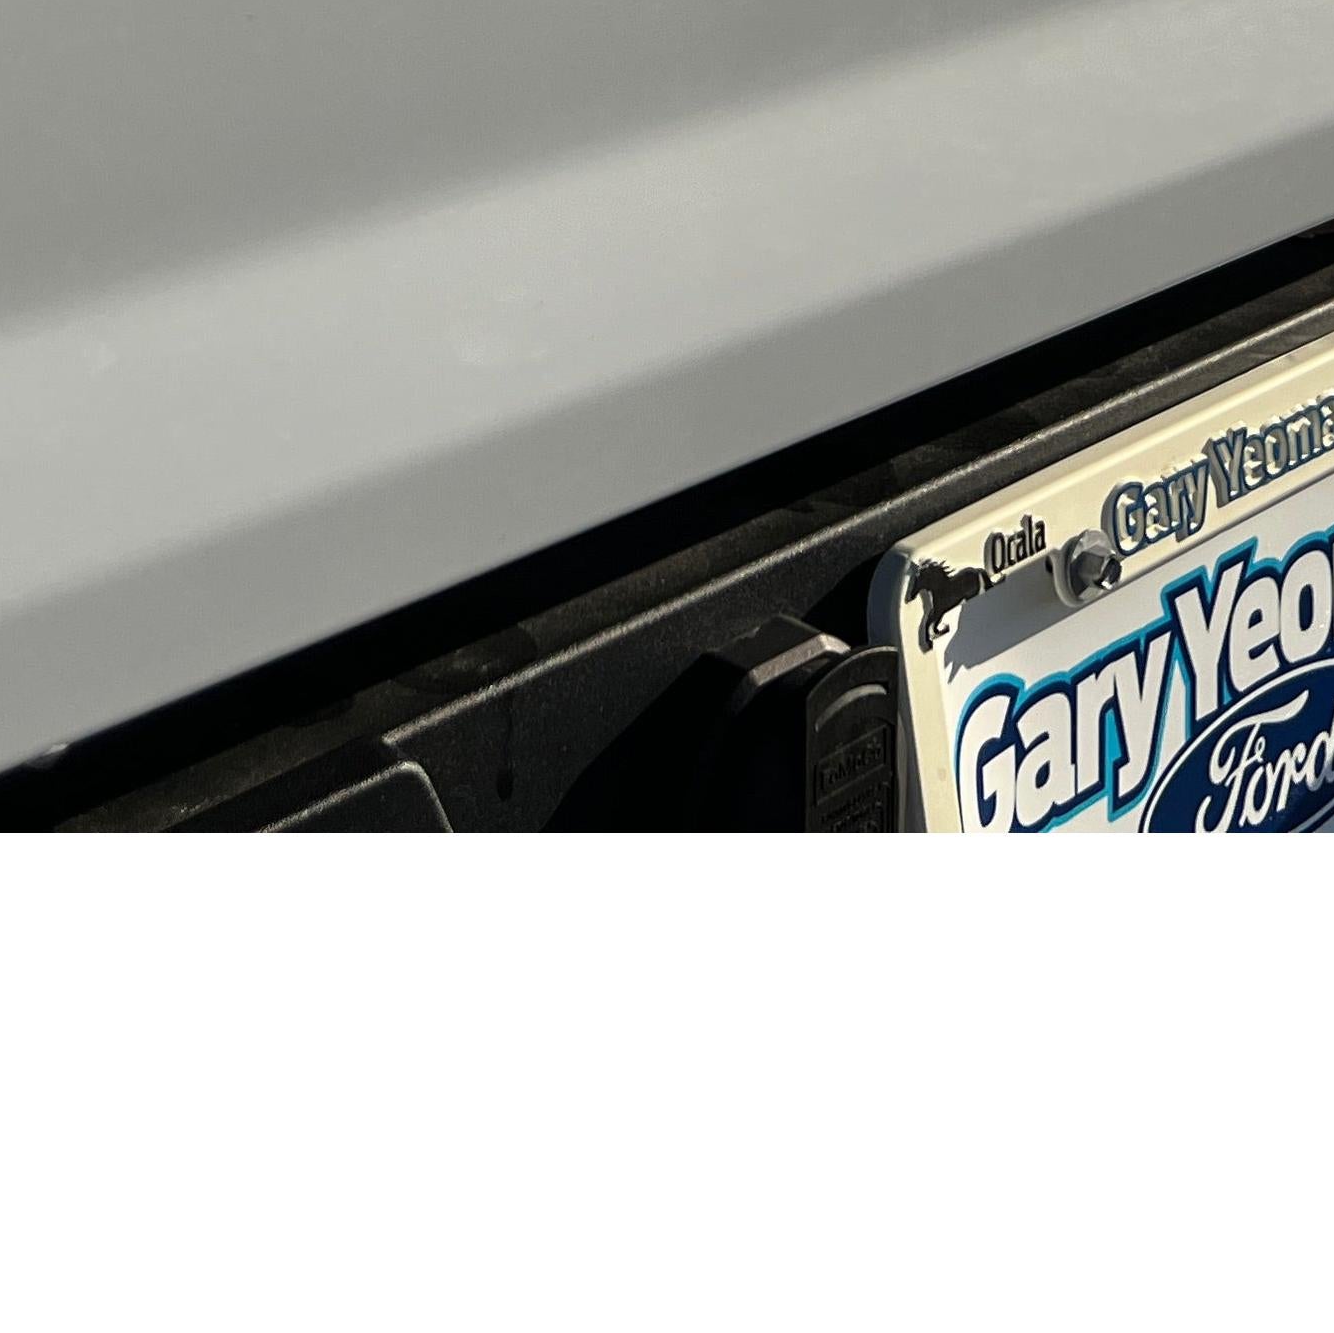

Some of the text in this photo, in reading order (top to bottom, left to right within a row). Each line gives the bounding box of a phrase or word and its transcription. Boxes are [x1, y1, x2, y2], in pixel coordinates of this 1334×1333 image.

[987, 514, 1047, 573] Ocala
[1108, 454, 1210, 556] Gary
[957, 631, 1177, 833] Gary
